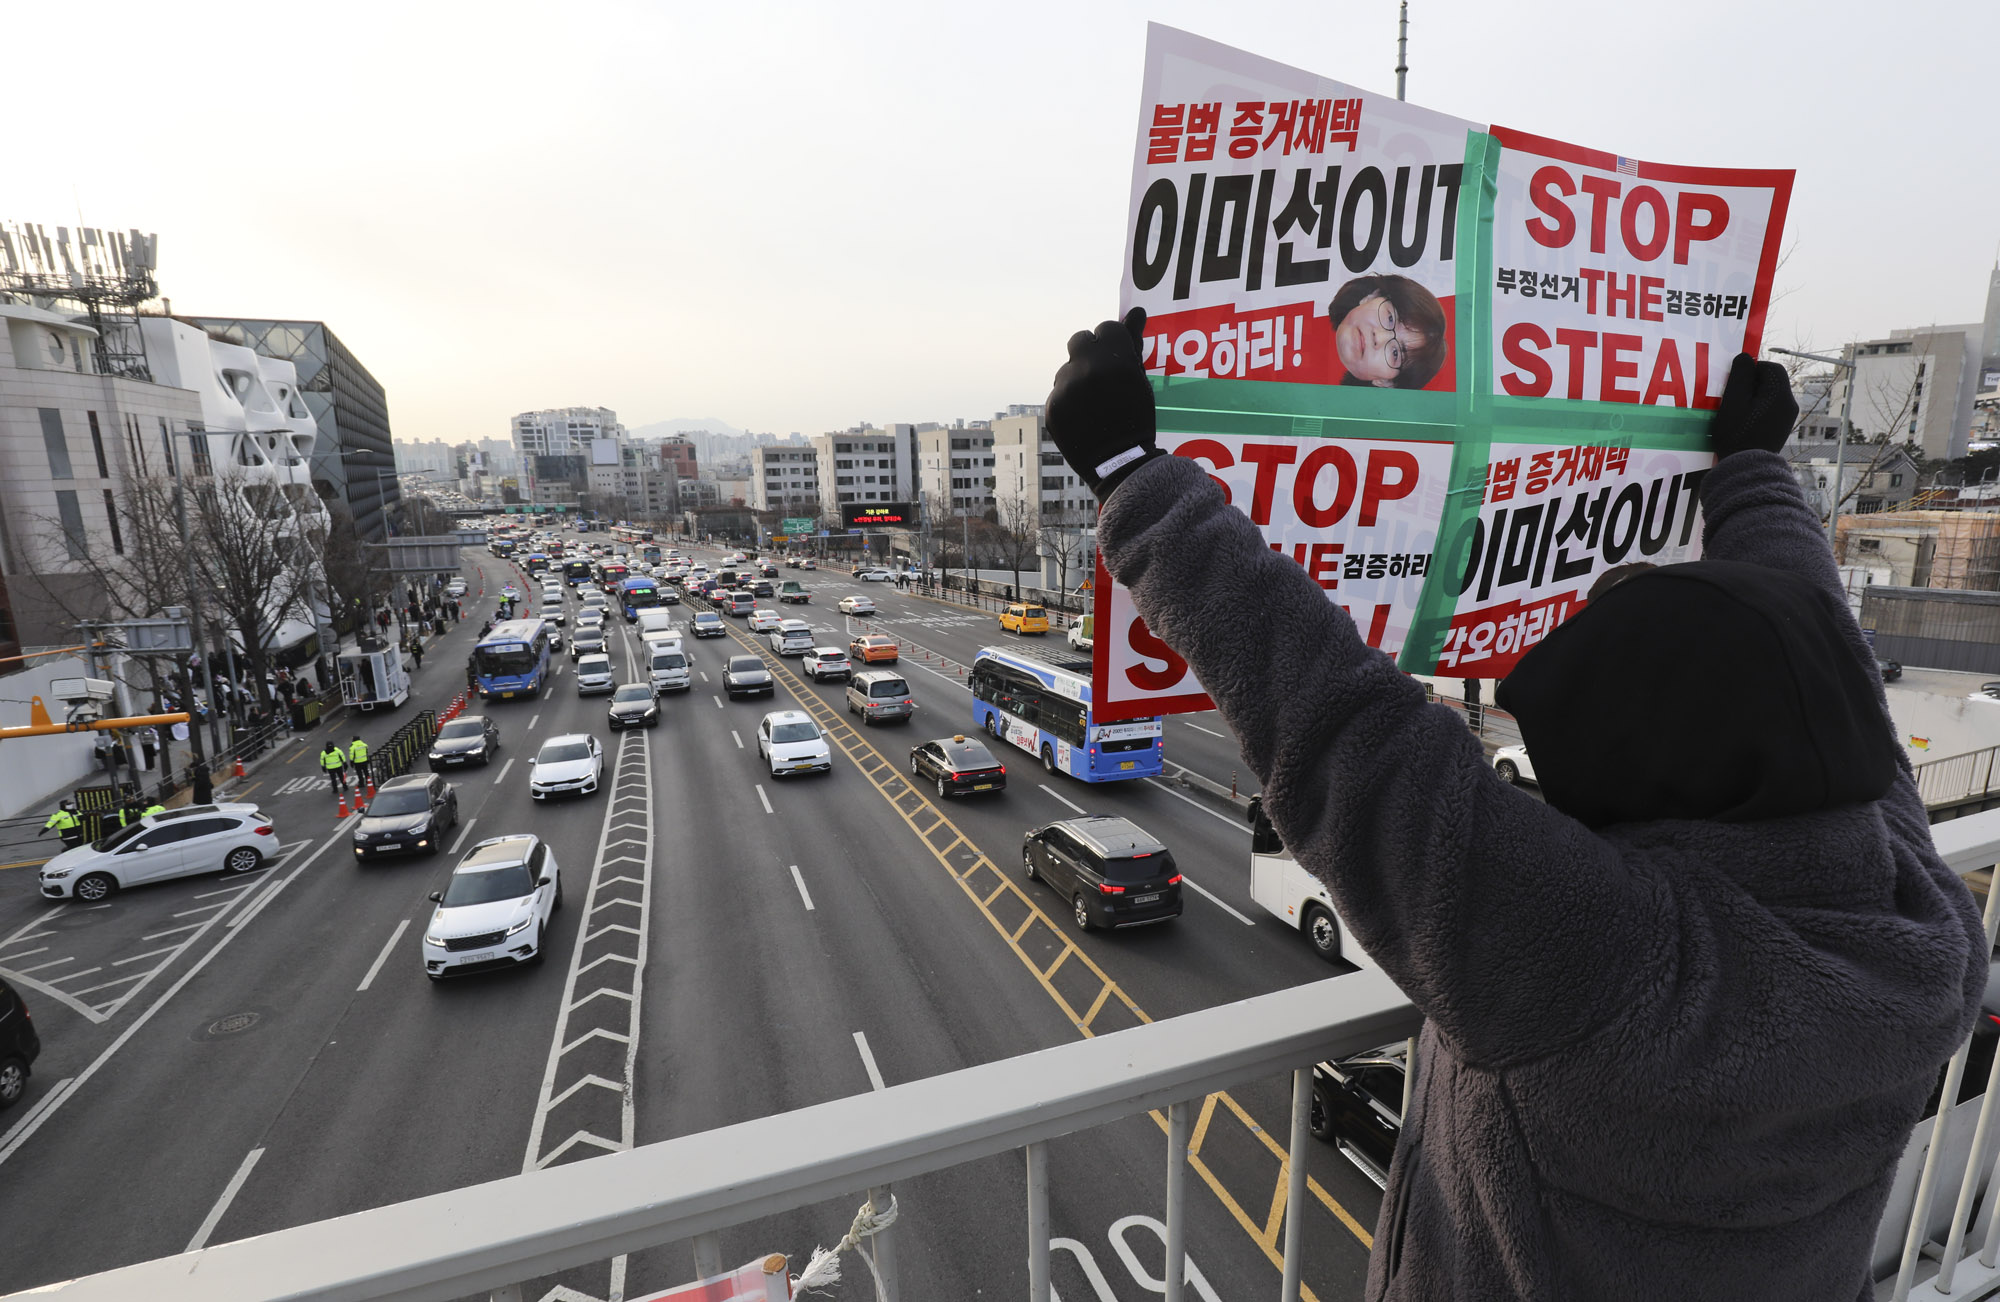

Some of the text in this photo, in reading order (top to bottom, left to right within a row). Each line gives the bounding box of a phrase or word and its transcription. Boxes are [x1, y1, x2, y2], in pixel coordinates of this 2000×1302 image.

[1147, 98, 1363, 165] 불법 증거채택
[1132, 164, 1472, 301] 이미선OUT
[1525, 165, 1730, 266] STOP
[1496, 267, 1748, 323] 부정선거 THE 검증하라
[1500, 322, 1724, 411] STEAL
[1460, 435, 1634, 510] 불법 증거채택
[1443, 468, 1712, 603] 이미선OUT
